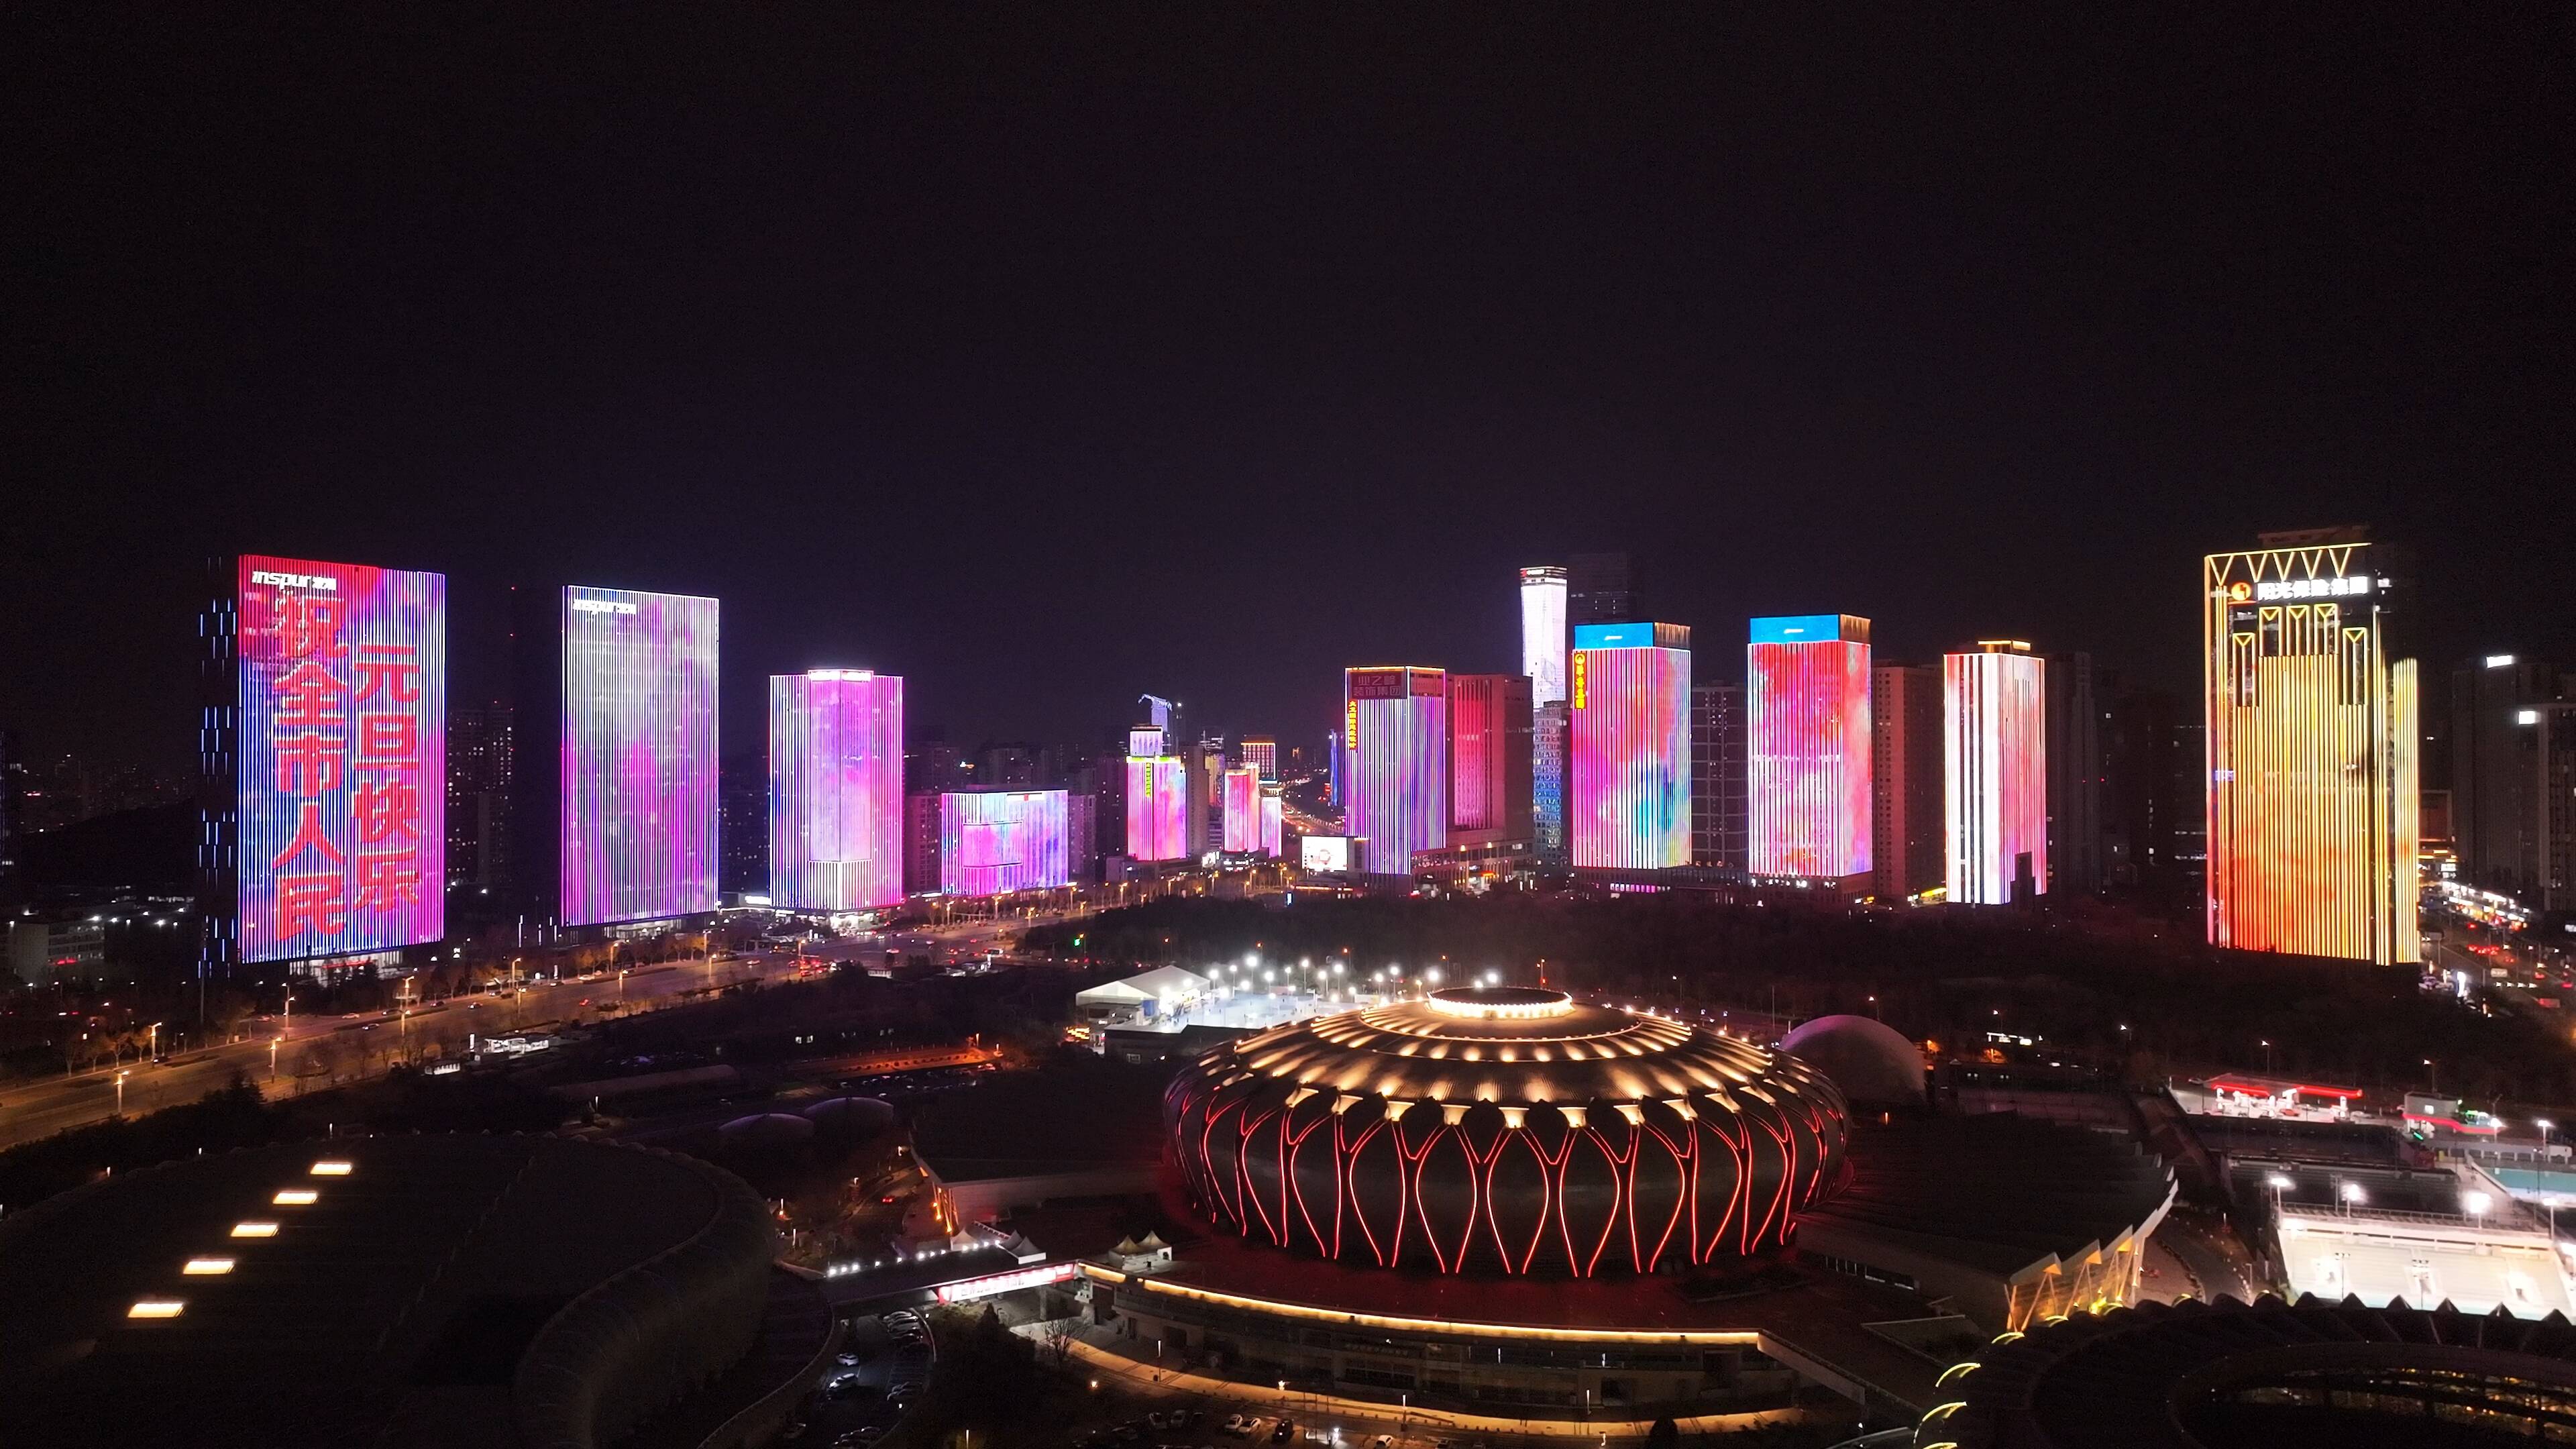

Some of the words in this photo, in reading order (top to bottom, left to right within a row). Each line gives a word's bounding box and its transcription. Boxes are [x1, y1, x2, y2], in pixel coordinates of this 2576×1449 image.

[252, 571, 311, 590] inspur
[1358, 675, 1395, 686] 业之峰
[1352, 686, 1401, 696] 装饰集团
[274, 590, 347, 941] 祝全市人民
[352, 643, 421, 913] 元旦快乐
